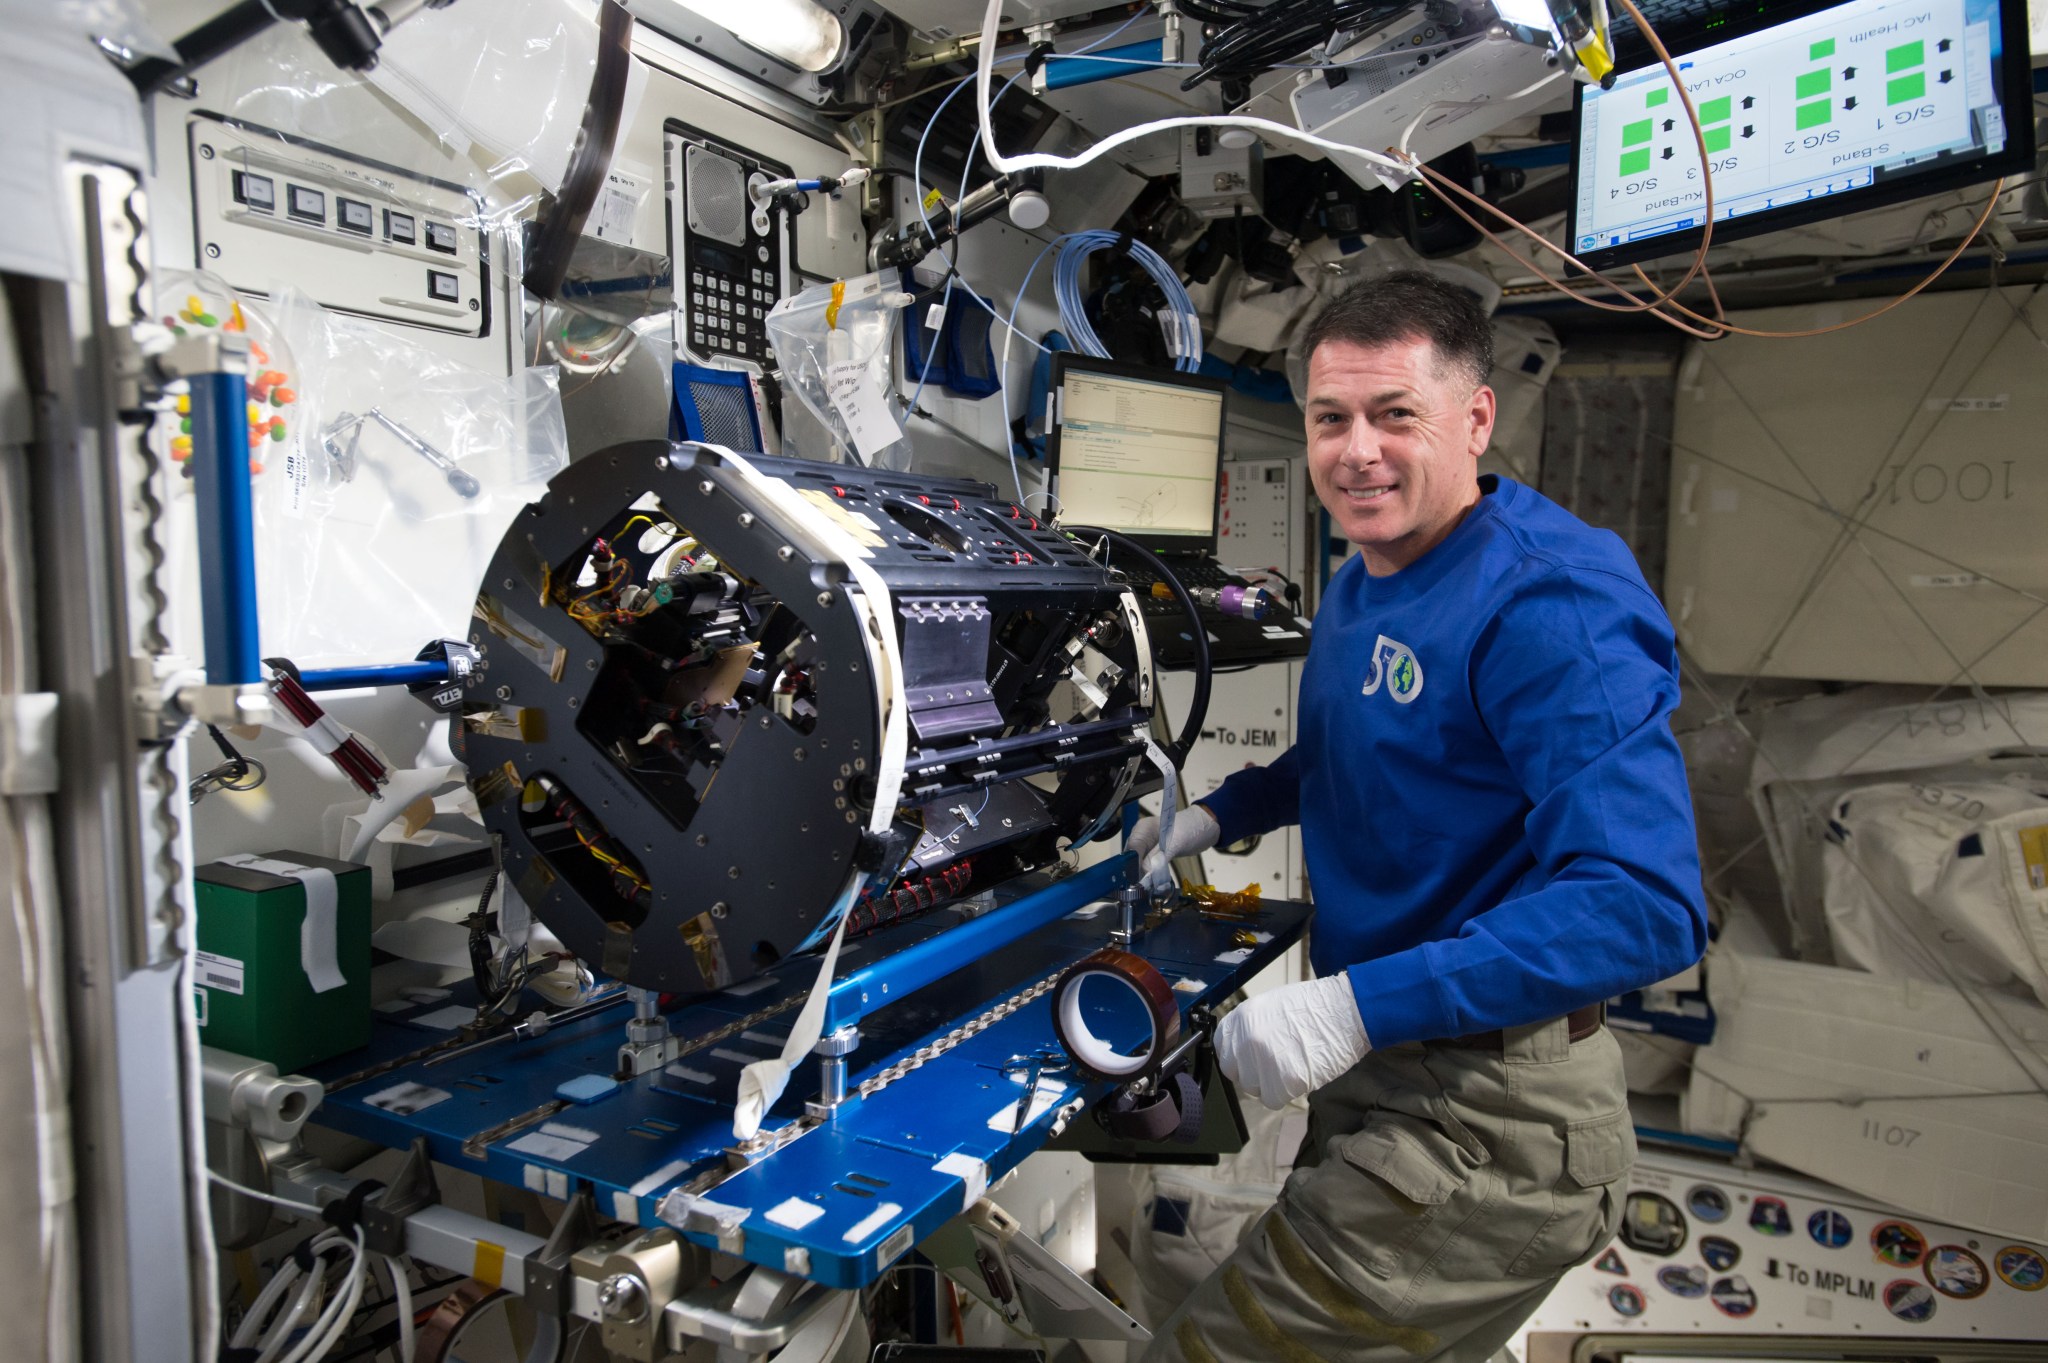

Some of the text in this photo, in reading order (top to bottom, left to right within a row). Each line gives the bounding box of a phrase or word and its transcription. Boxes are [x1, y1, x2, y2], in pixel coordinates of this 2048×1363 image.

[1849, 12, 1931, 43] IAC Health
[1714, 69, 1747, 85] OCA
[1877, 104, 1935, 130] S/G 1
[1784, 129, 1841, 154] S/G 2
[1832, 143, 1890, 165] S-Band
[1686, 167, 1697, 180] 3
[1610, 177, 1658, 200] S/G 4
[1645, 190, 1703, 212] Ku-Band
[286, 455, 295, 479] JSB
[1890, 461, 2016, 505] 1001
[1361, 634, 1424, 704] 50
[1216, 727, 1277, 747] To JEM
[1786, 1261, 1875, 1301] To MPLM
